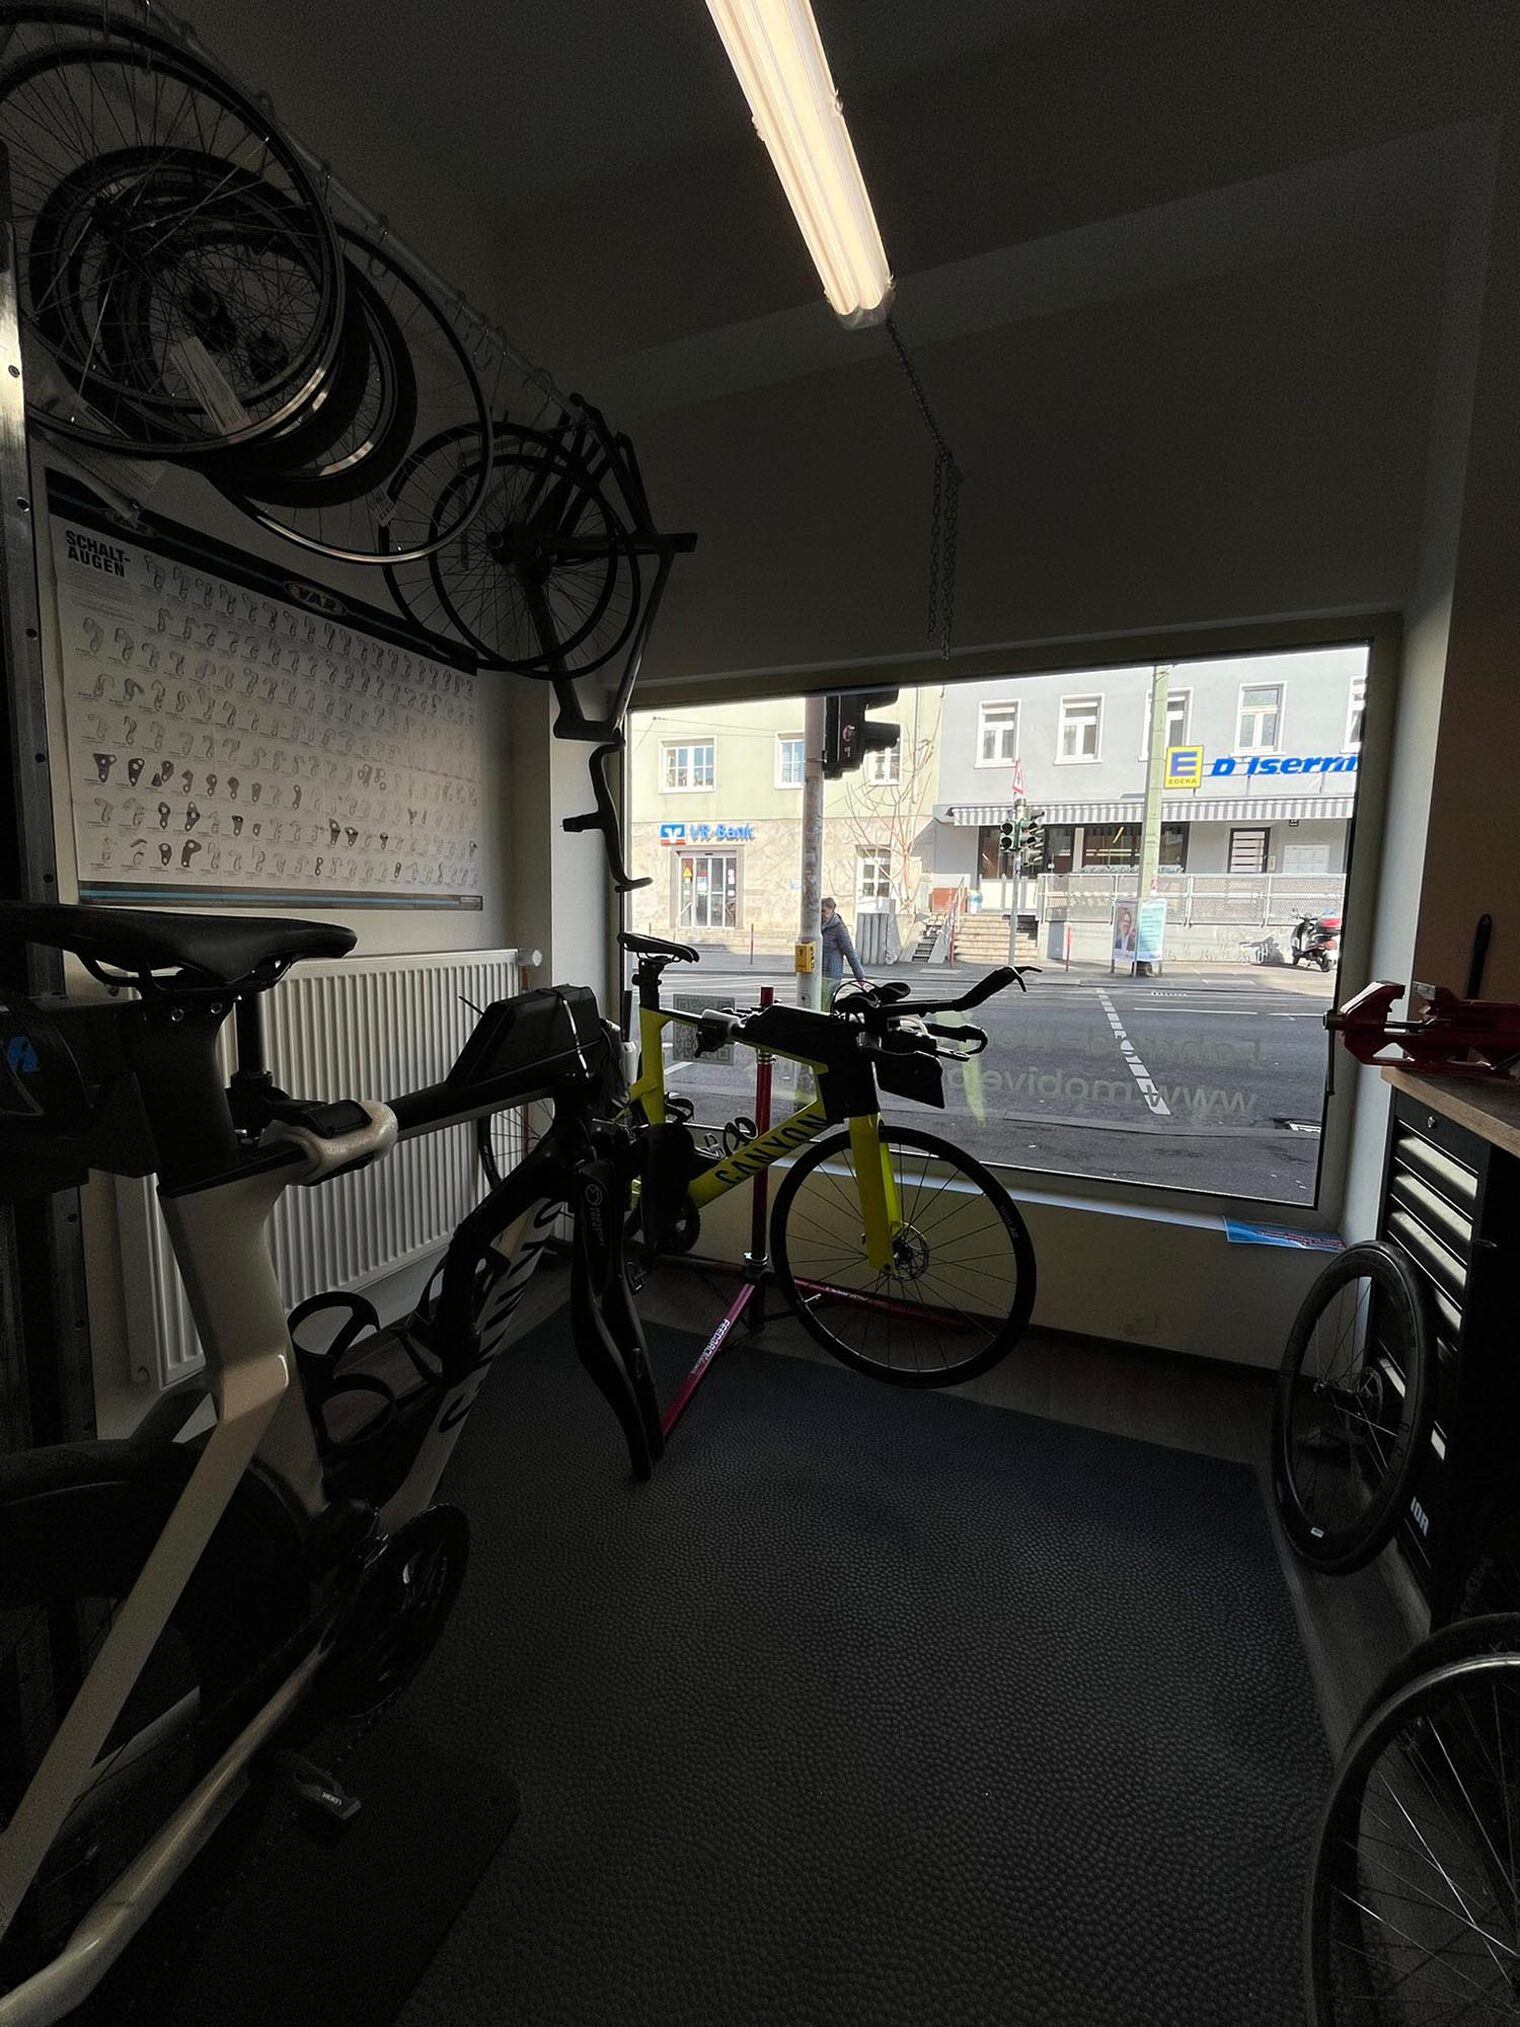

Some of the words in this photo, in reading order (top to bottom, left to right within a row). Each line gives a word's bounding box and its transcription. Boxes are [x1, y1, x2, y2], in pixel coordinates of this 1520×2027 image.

[66, 530, 130, 563] SCHALT-
[69, 546, 125, 577] AUGEN
[1170, 751, 1197, 777] E
[714, 1113, 834, 1184] CANYON
